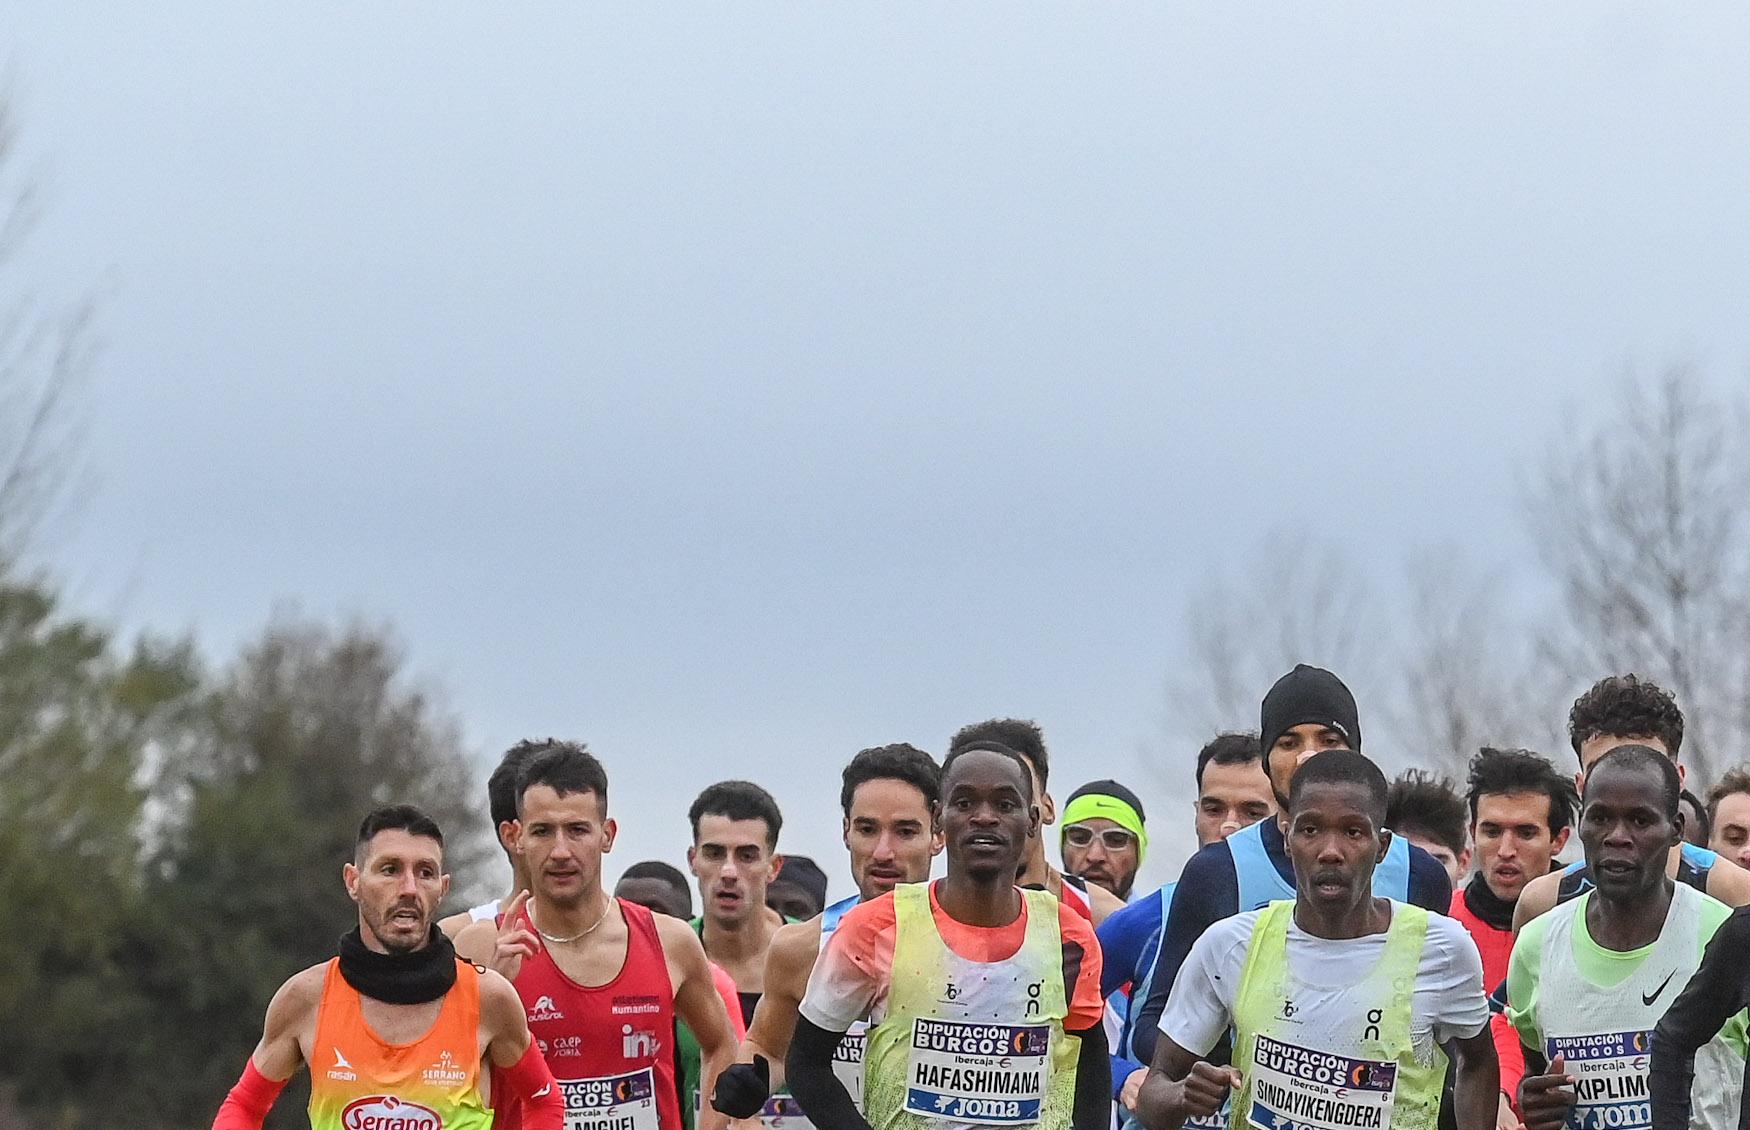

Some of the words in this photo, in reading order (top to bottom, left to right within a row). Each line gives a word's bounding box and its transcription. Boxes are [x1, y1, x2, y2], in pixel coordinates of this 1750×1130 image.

[611, 1003, 660, 1015] Numantino
[916, 1020, 1011, 1041] DIPUTACIÓN
[915, 1033, 1010, 1056] BURGOS
[1555, 1033, 1625, 1048] DIPUTACIÓN
[954, 1056, 994, 1067] Ibercaja
[1258, 1037, 1350, 1073] DIPUTACIÓN
[422, 1069, 466, 1080] SERRANO
[1256, 1049, 1347, 1086] BURGOS
[1580, 1059, 1626, 1073] Ibercaja
[915, 1062, 1040, 1095] HAFASHIMANA
[1290, 1078, 1330, 1096] Ibercaja
[1257, 1079, 1382, 1129] SINDAYIKENGDERA
[1381, 1093, 1388, 1102] 6
